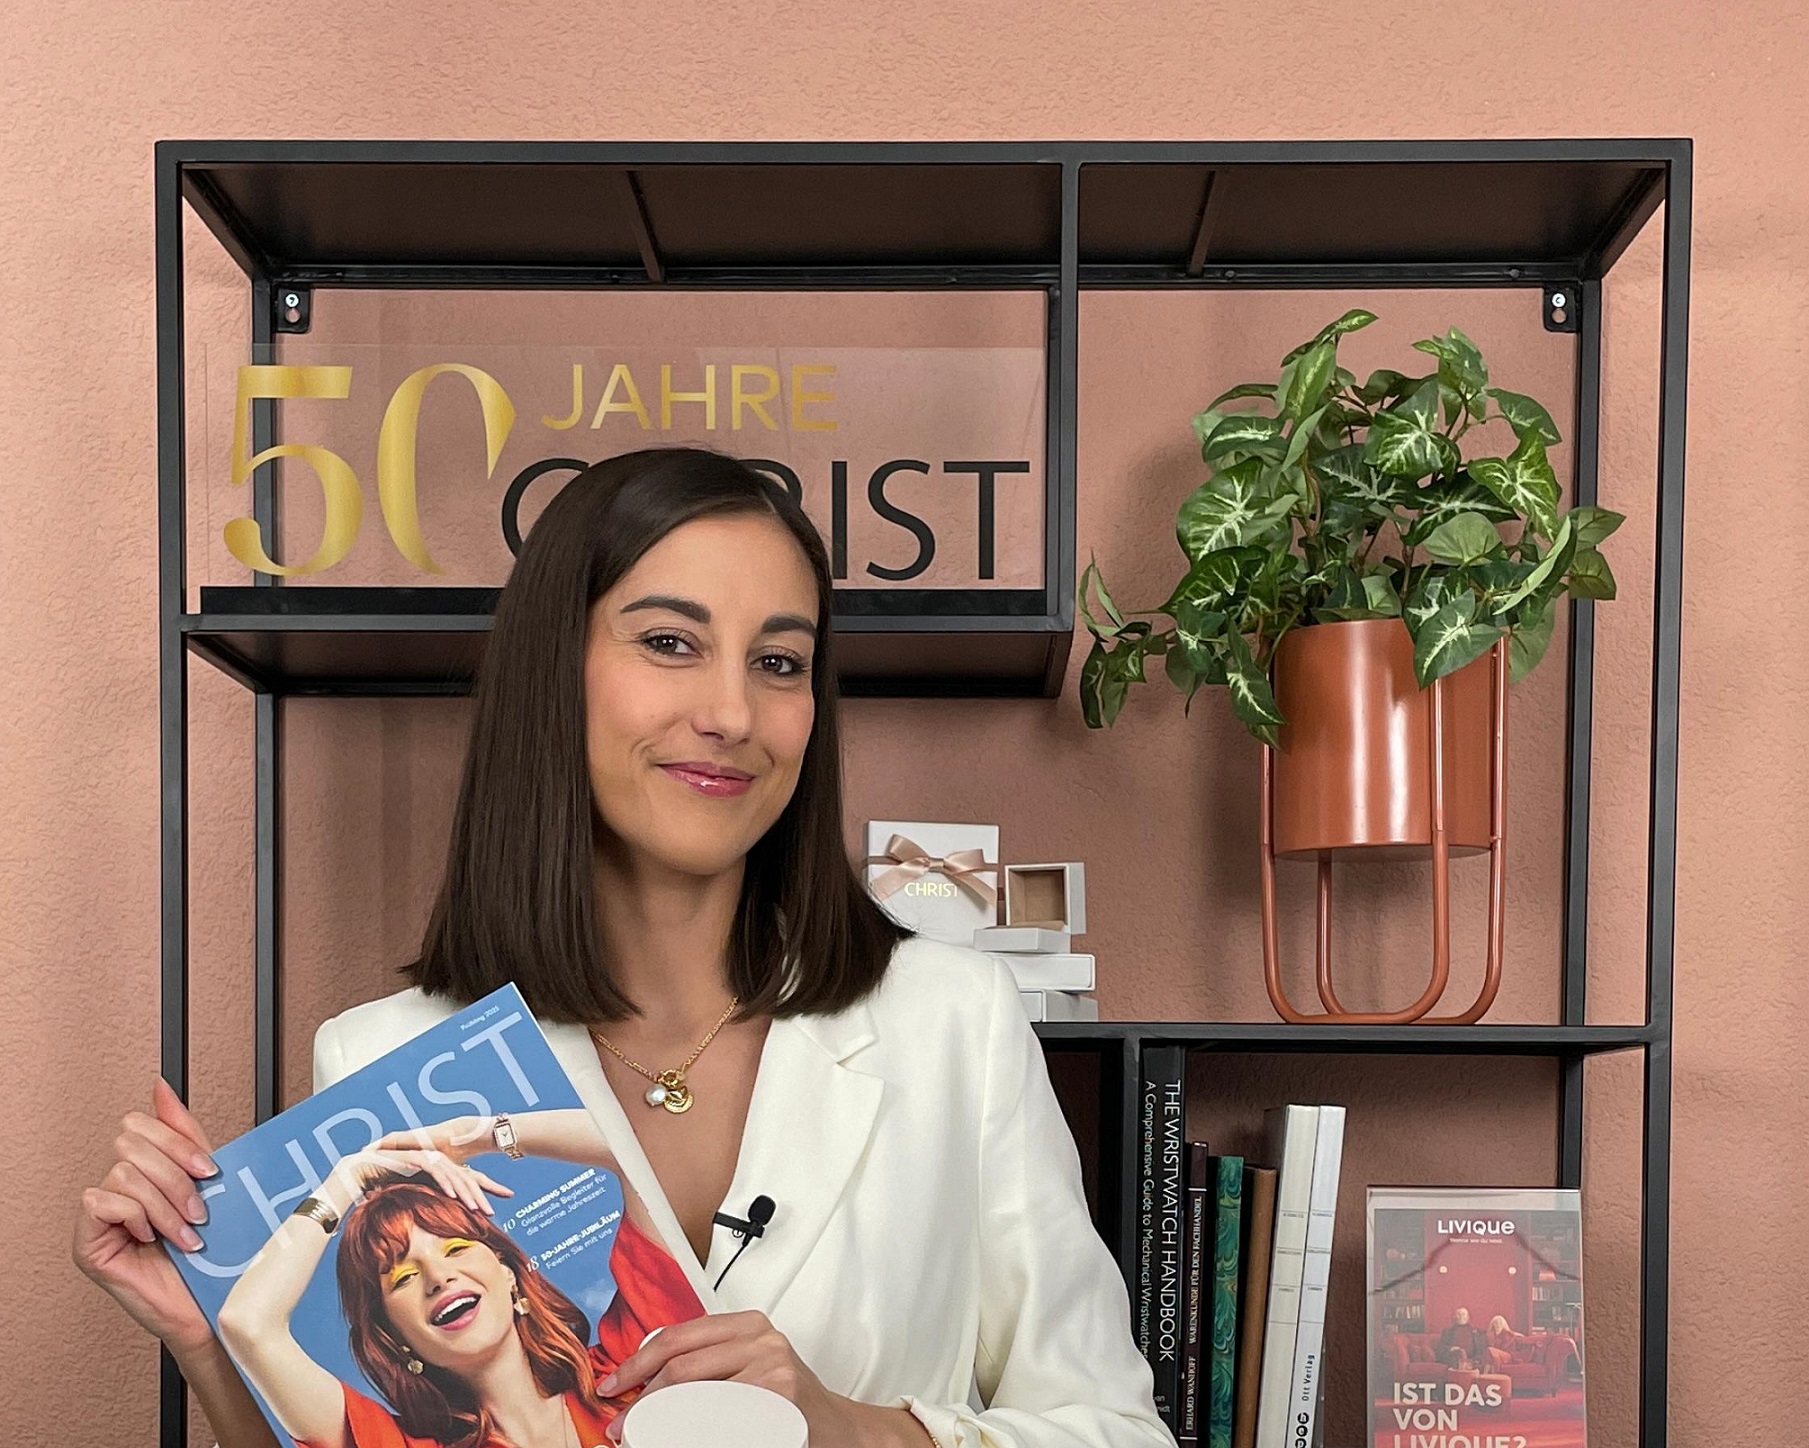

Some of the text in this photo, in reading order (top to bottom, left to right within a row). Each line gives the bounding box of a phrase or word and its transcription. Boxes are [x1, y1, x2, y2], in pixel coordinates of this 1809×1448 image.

[541, 364, 838, 431] JAHRE
[223, 364, 516, 577] 50
[501, 458, 1030, 581] CIST
[904, 881, 958, 898] CHRIST
[1145, 1081, 1157, 1091] A
[1142, 1093, 1157, 1176] Comprehensive
[515, 1168, 596, 1219] CHARMING SUMMER
[559, 1181, 595, 1205] Begleiter
[1142, 1179, 1155, 1211] Guide
[526, 1226, 539, 1236] die
[1142, 1214, 1153, 1226] to
[1159, 1079, 1181, 1362] THE WRISTWATCH HANDBOOK
[1141, 1229, 1154, 1286] Mechanical
[1301, 1354, 1315, 1402] Ott Verlag
[1394, 1382, 1502, 1406] IST DAS
[1392, 1408, 1458, 1431] VON
